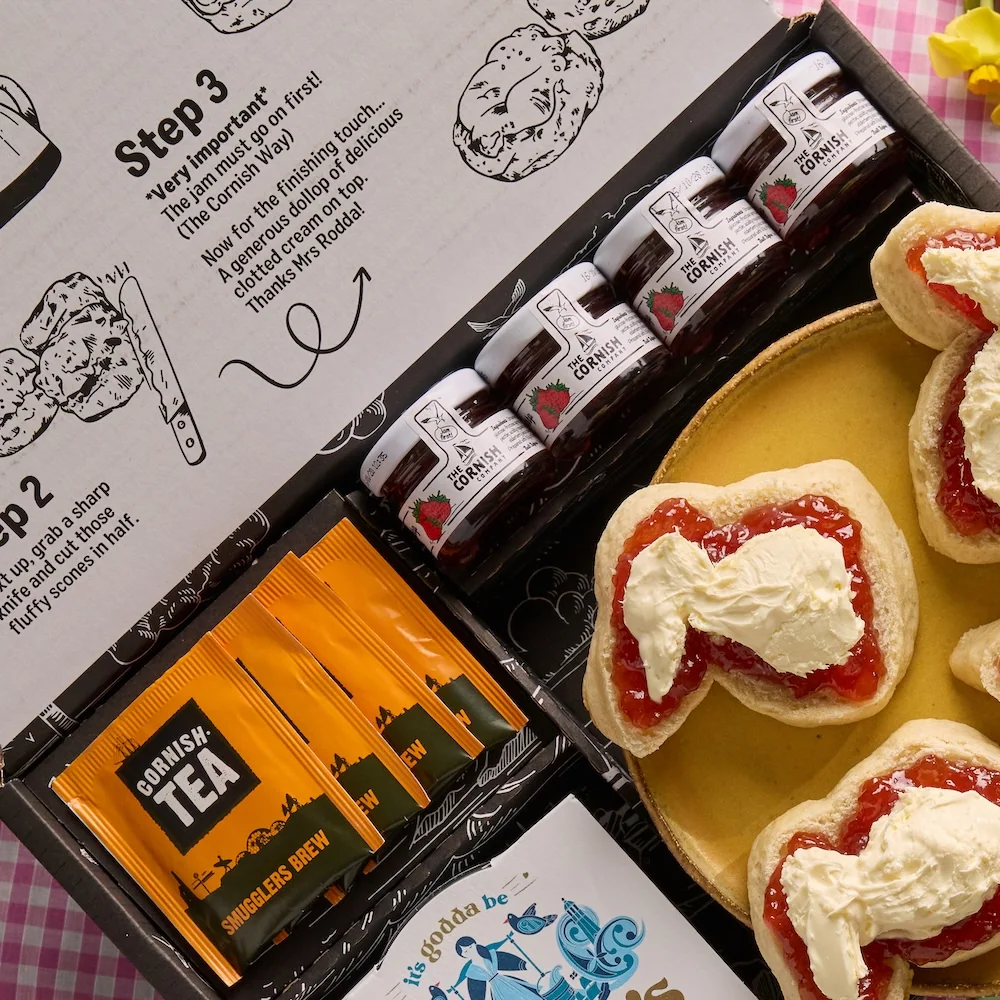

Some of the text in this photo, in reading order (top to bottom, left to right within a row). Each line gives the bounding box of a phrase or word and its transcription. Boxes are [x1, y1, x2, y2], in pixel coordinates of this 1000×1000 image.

[115, 69, 228, 178] Step 3
[160, 70, 323, 223] The jam must go on first!
[799, 129, 850, 176] CORNISH
[823, 140, 853, 167] COMPANY
[176, 128, 294, 240] (The Cornish Way)
[200, 101, 386, 267] Now for the finishing touch...
[793, 149, 810, 165] THE
[217, 108, 404, 283] A generous dollop of delicious
[234, 176, 369, 298] clotted cream on top.
[245, 201, 366, 314] Thanks Mrs Rodda!
[680, 257, 696, 274] THE
[685, 237, 736, 284] CORNISH
[709, 248, 740, 275] COMPANY
[567, 354, 584, 370] THE
[573, 336, 623, 381] CORNISH
[597, 347, 627, 372] COMPANY
[20, 475, 54, 509] 2
[446, 465, 463, 481] THE
[453, 444, 502, 491] CORNISH
[477, 455, 507, 482] COMPANY
[10, 557, 35, 577] up,
[31, 526, 63, 560] grab
[61, 516, 74, 528] a
[72, 481, 111, 519] sharp
[29, 559, 56, 588] and
[54, 539, 80, 565] cut
[75, 507, 115, 543] those
[9, 513, 140, 635] fluffy scones in half.
[152, 747, 240, 827] TEA
[220, 829, 330, 936] SMUGGLERS BREW
[403, 961, 426, 987] it's
[481, 893, 509, 910] be
